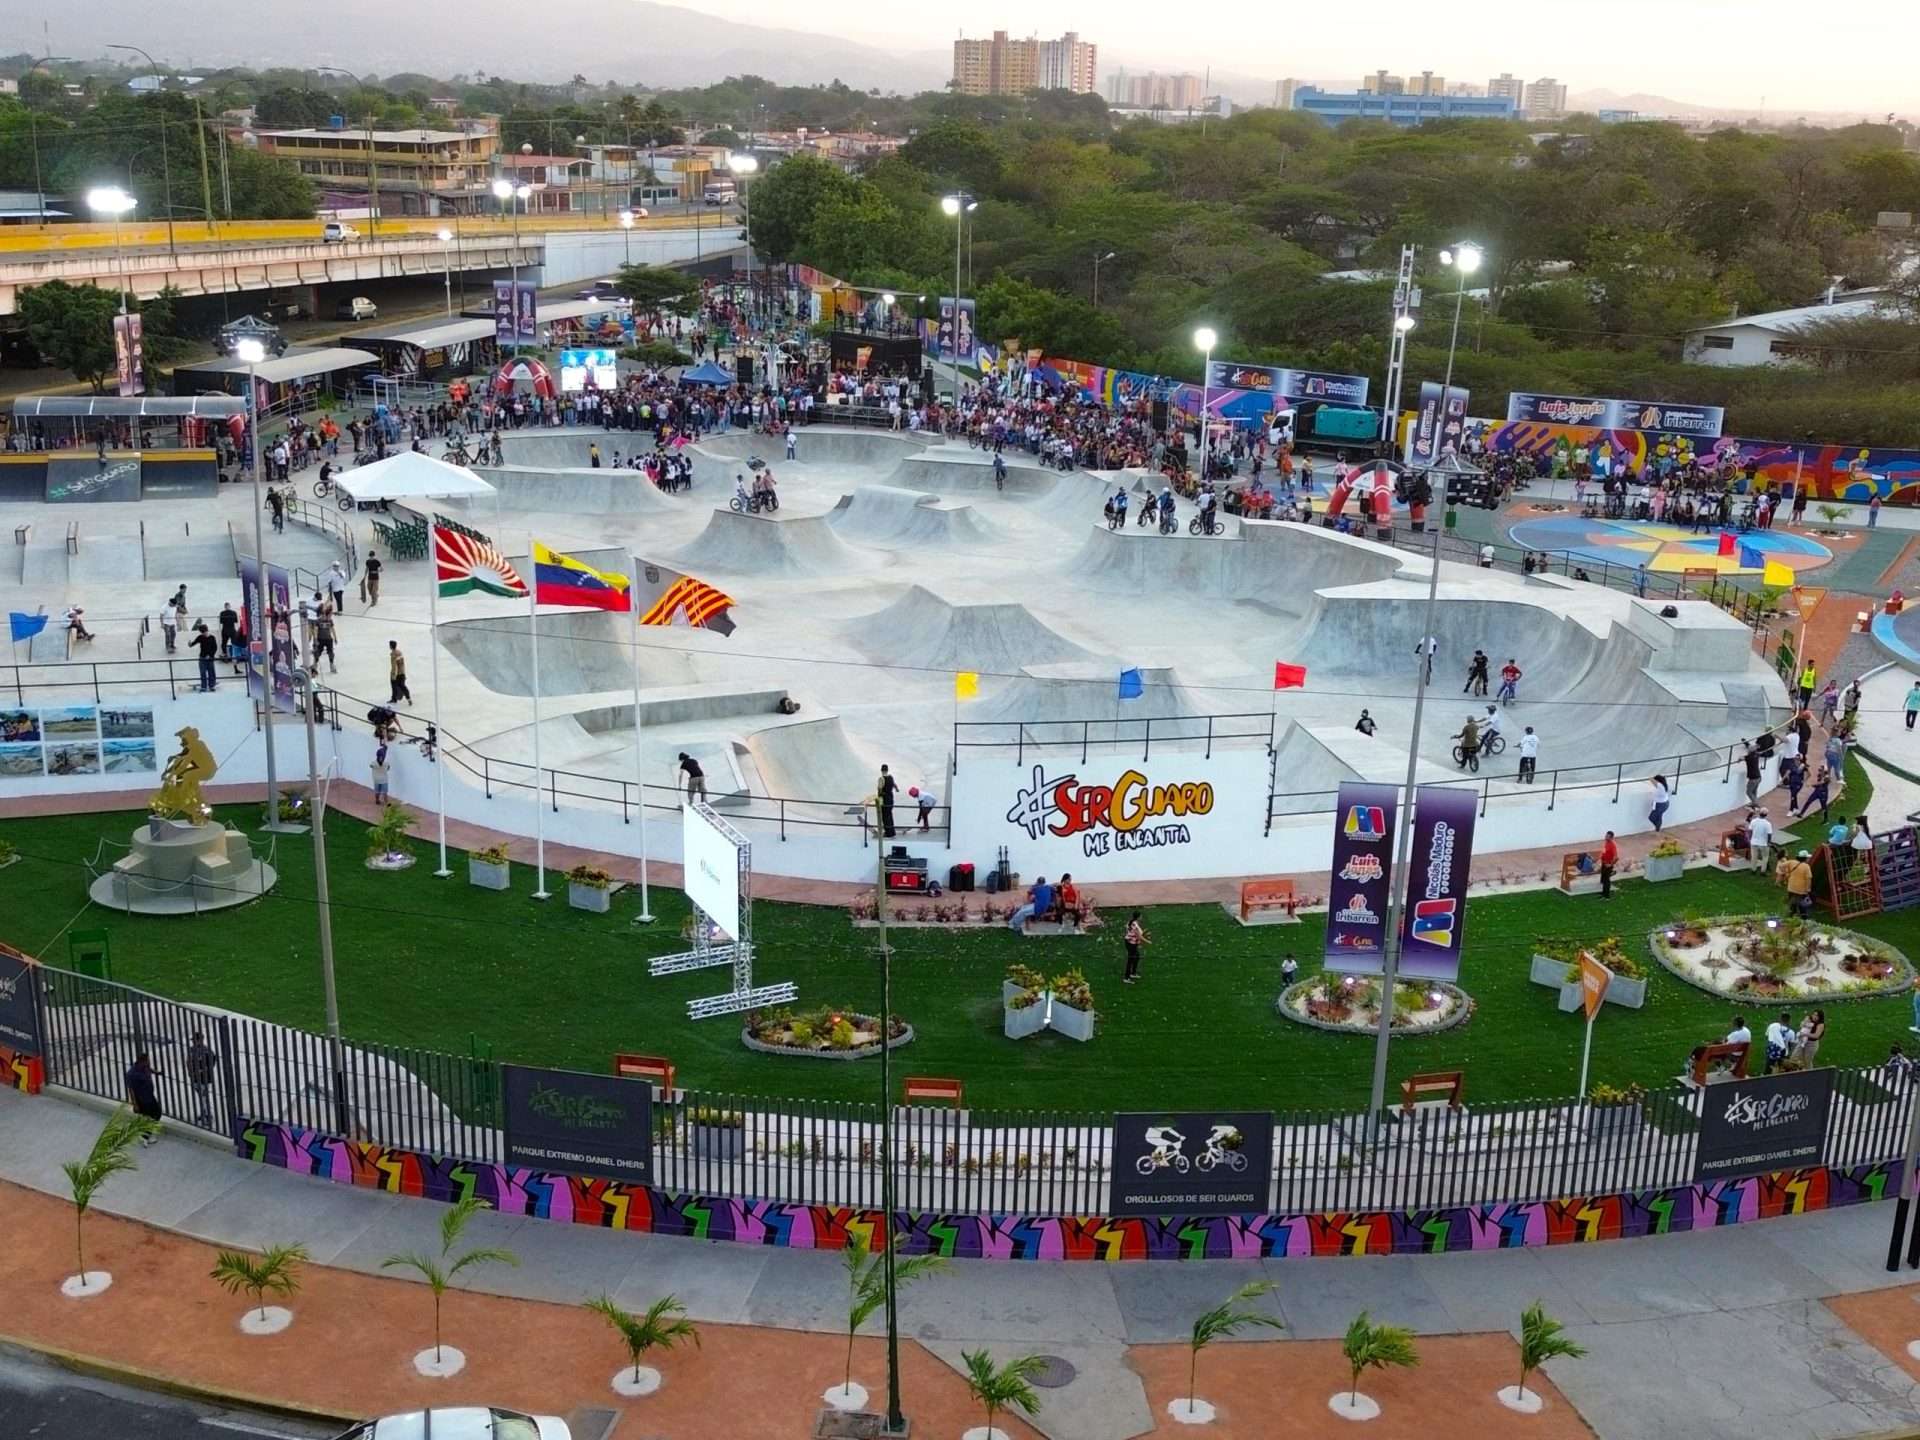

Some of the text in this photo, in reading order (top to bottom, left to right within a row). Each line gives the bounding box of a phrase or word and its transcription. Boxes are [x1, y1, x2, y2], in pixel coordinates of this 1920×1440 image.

[1664, 416, 1716, 430] Iribarren
[1084, 824, 1190, 857] ME ENCANTA
[1351, 853, 1380, 866] Luis
[512, 1145, 645, 1170] PARQUE EXTREMO DANIEL DHERS
[1702, 1158, 1731, 1171] PARQUE
[1733, 1154, 1765, 1166] EXTREMO
[1767, 1150, 1791, 1161] DANIEL
[1125, 1193, 1254, 1204] ORGULLOSOS DE SER GUAROS
